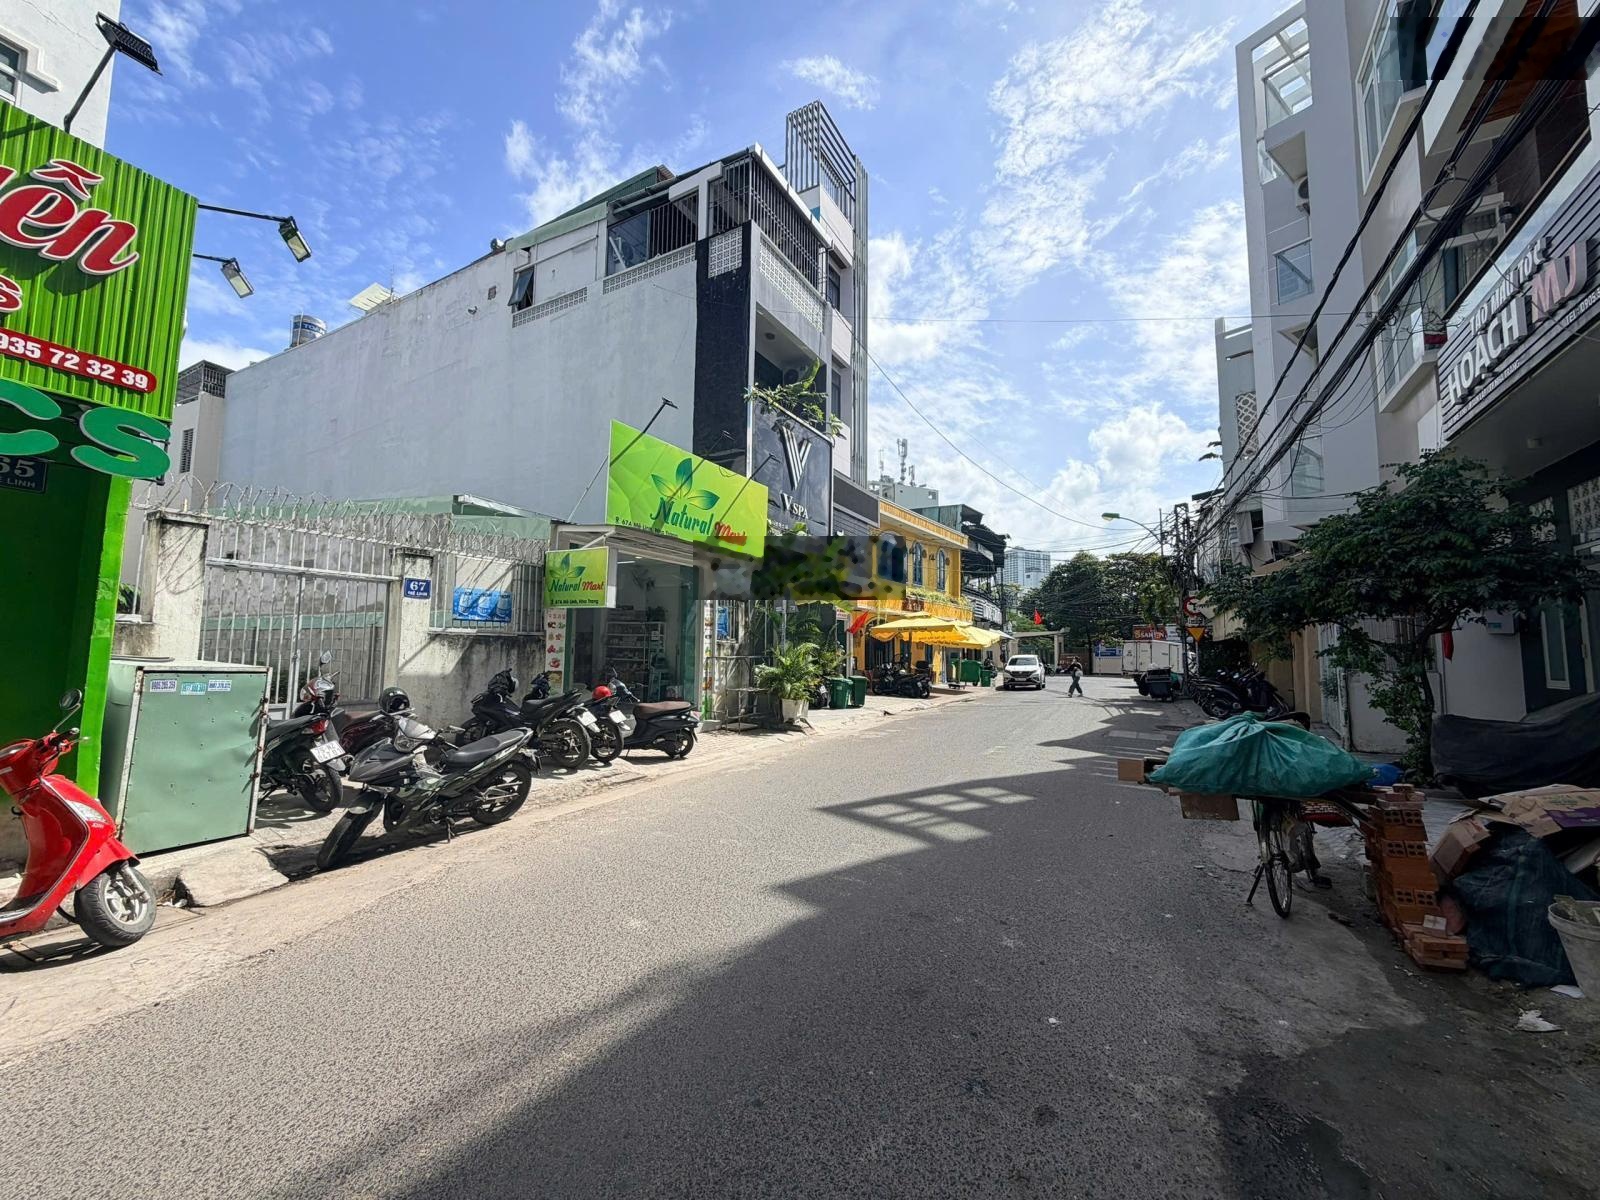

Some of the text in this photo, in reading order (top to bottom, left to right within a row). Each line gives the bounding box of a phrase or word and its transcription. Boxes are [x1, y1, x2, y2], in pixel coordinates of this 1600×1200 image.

[50, 347, 80, 370] 72
[86, 359, 116, 380] 32
[121, 369, 149, 389] 39
[7, 477, 36, 489] LINH
[650, 496, 714, 536] Natural
[410, 581, 426, 591] 67
[547, 577, 604, 593] Natural Mart
